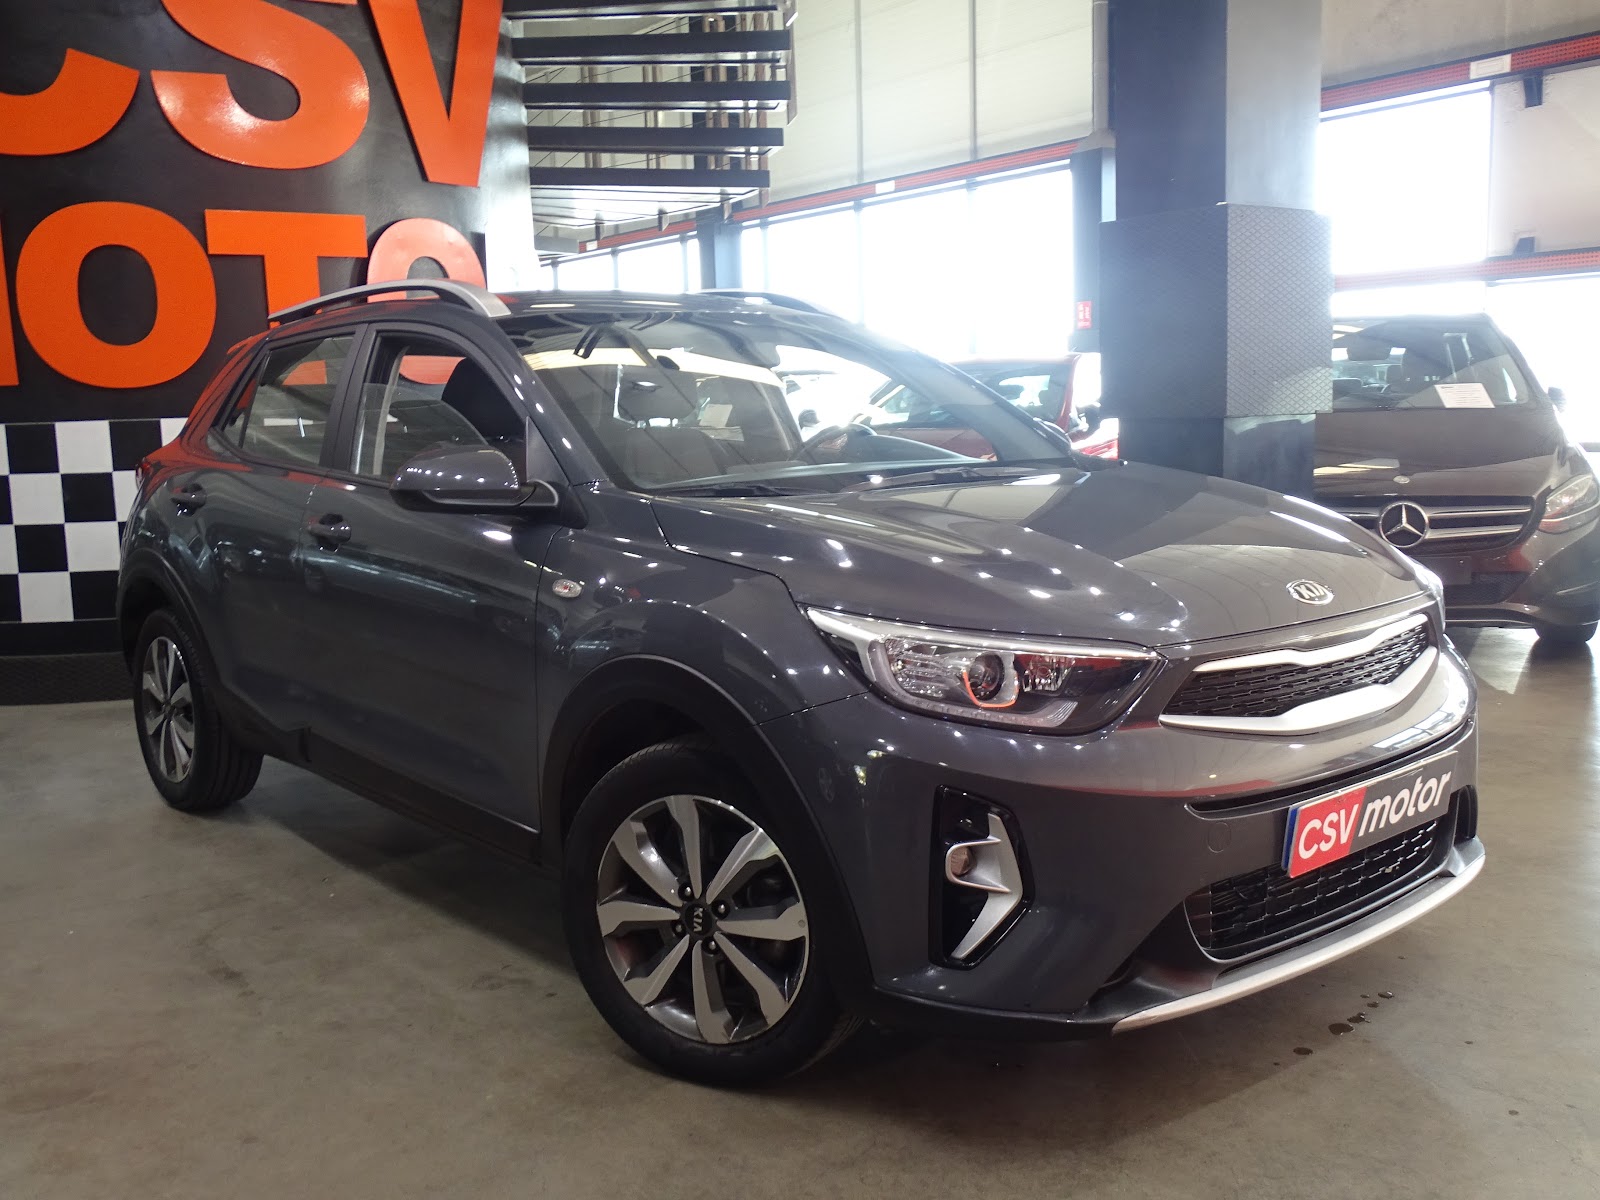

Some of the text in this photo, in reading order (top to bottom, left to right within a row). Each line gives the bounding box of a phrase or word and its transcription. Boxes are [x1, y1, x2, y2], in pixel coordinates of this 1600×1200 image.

[1292, 582, 1327, 600] KIA
[1298, 771, 1452, 860] CSV motor
[693, 907, 703, 932] KIA
